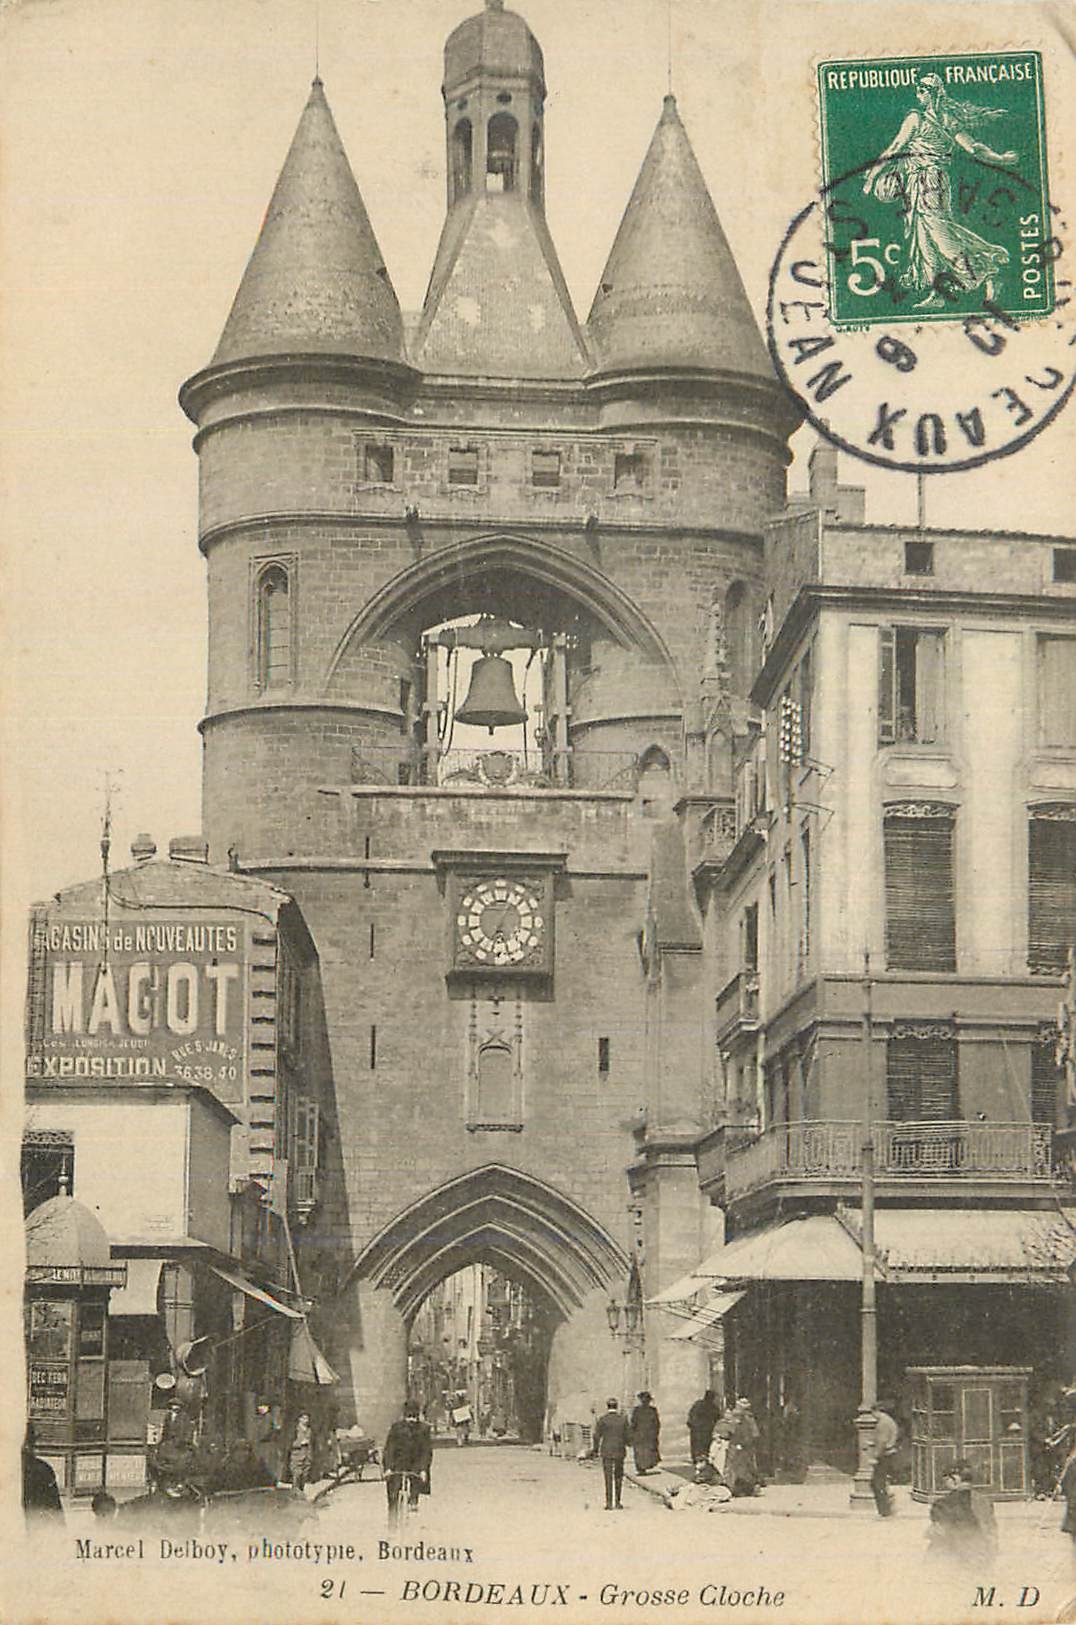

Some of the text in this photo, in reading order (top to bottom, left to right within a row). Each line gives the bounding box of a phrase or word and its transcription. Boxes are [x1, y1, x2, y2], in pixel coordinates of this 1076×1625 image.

[114, 928, 132, 951] de
[136, 926, 238, 952] NOUVEAUTES
[51, 960, 240, 1036] MAGOT
[27, 1055, 166, 1077] EXPOSITION
